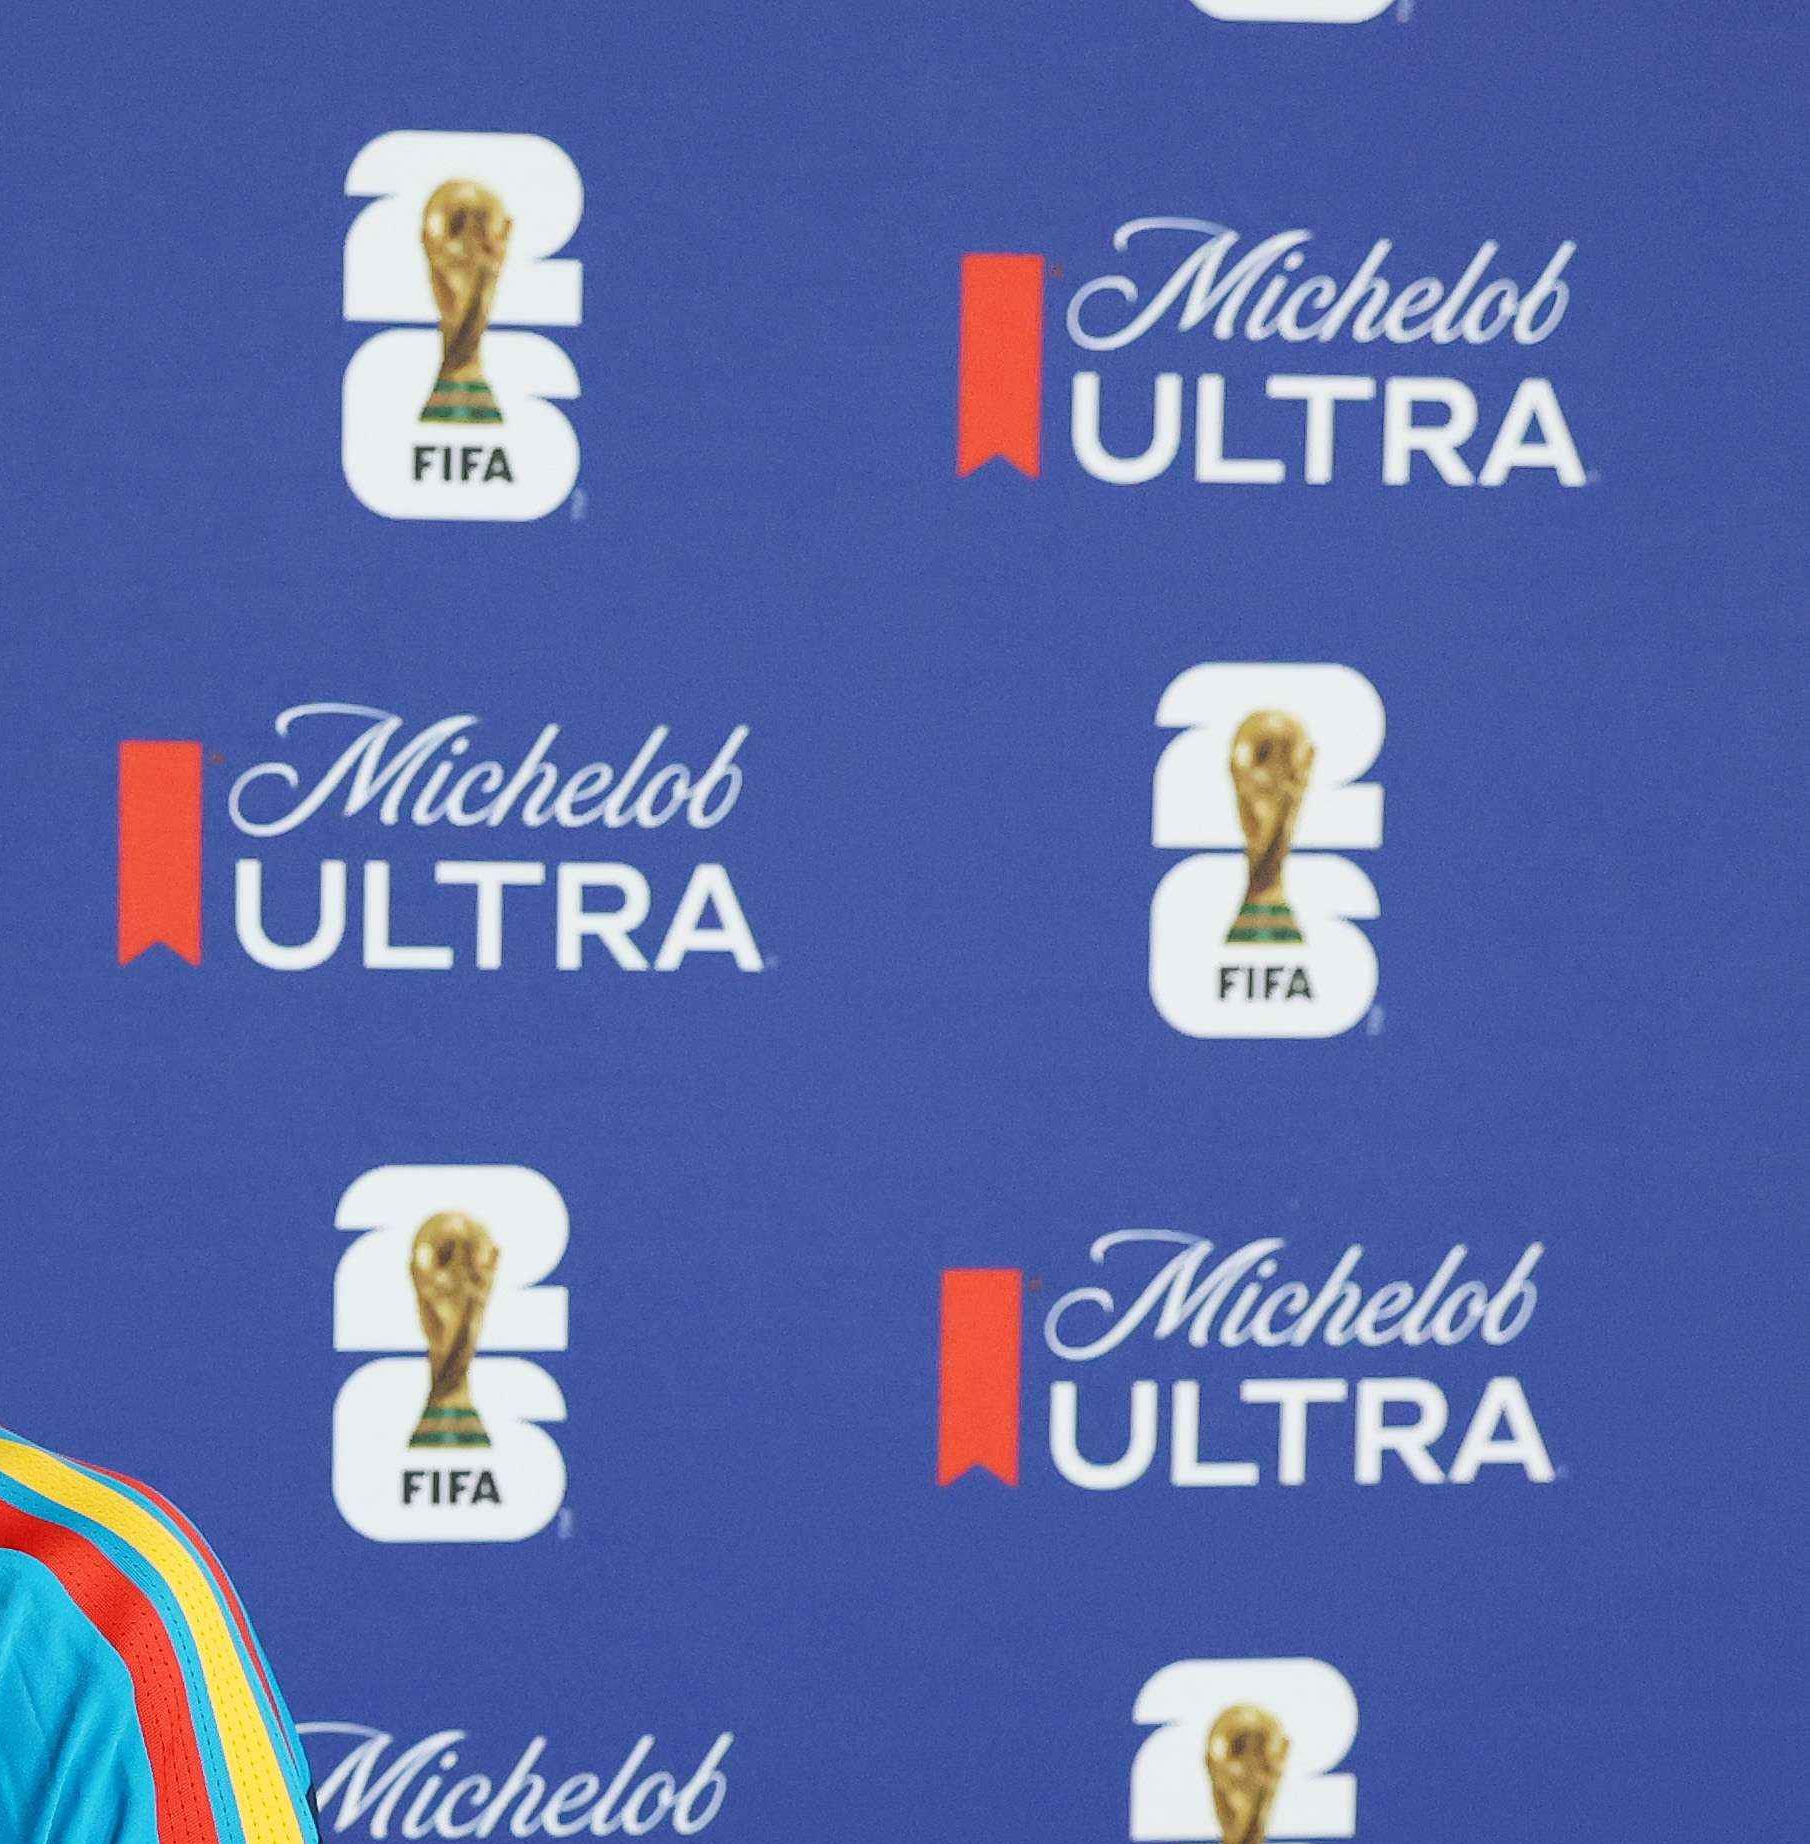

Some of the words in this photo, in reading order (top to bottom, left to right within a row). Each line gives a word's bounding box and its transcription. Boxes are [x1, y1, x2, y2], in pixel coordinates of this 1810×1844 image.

[1067, 218, 1576, 351] Michelob
[412, 444, 515, 484] FIFA
[1072, 372, 1586, 487] ULTRA
[229, 703, 749, 836] Michelob
[236, 859, 764, 972] ULTRA
[1217, 965, 1314, 1001] FIFA
[1045, 1230, 1544, 1360] Michelob
[401, 1468, 503, 1507] FIFA
[1050, 1377, 1556, 1490] ULTRA
